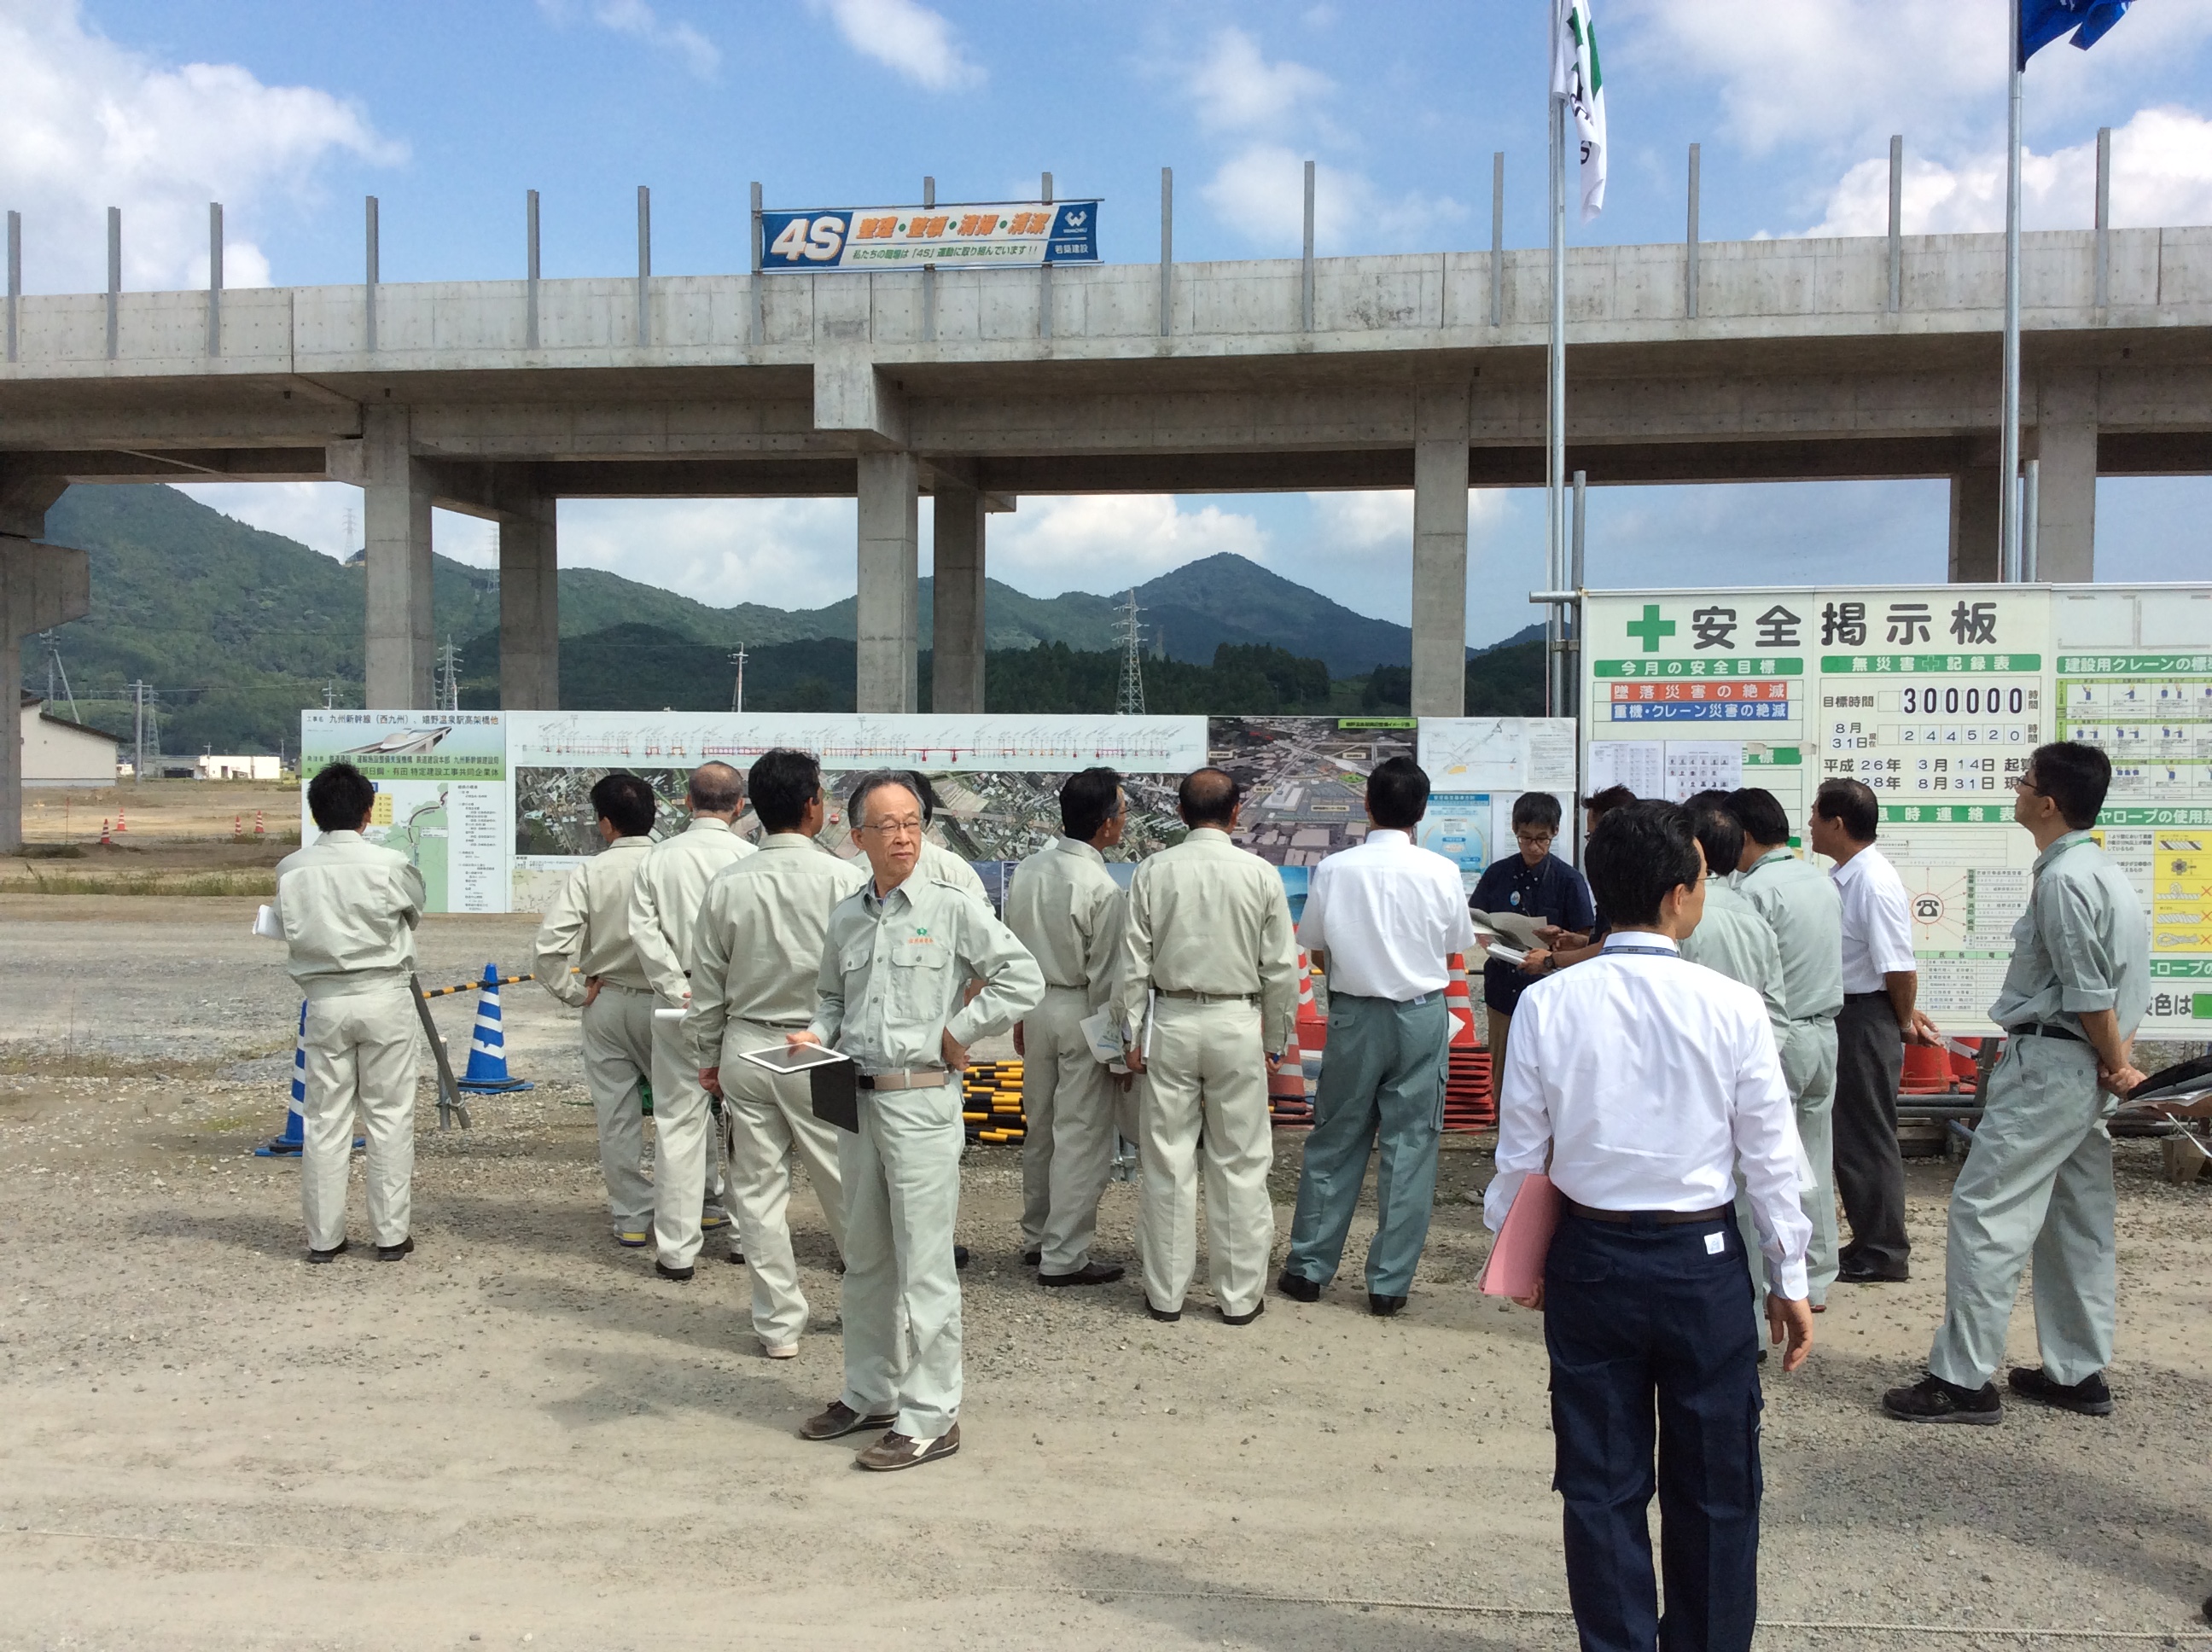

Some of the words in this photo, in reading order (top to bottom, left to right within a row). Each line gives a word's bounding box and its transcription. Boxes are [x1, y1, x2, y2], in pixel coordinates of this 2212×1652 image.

[770, 216, 846, 262] 4S
[1691, 601, 1998, 650] 安全掲示板
[1621, 660, 1776, 676] 今月の安全目標
[1852, 655, 2011, 672] 無災害記録表
[2065, 656, 2212, 672] 建設用クレーンの標
[1614, 683, 1785, 700] 墜落災害の絶滅
[1823, 695, 1874, 708] 目標時間
[1903, 687, 2023, 714] 300000
[2028, 689, 2039, 710] 時間
[1614, 703, 1786, 719] 重機・クレーン災害の絶滅
[1835, 722, 1862, 734] 8月
[1831, 737, 1867, 749] 31日
[1904, 730, 2020, 742] 244520
[2028, 724, 2039, 744] 時間
[1824, 758, 1901, 773] 平成26年
[1918, 758, 1948, 772] 3月
[1959, 758, 1995, 772] 14日
[1918, 777, 1948, 790] 8月
[1954, 777, 1995, 790] 31日
